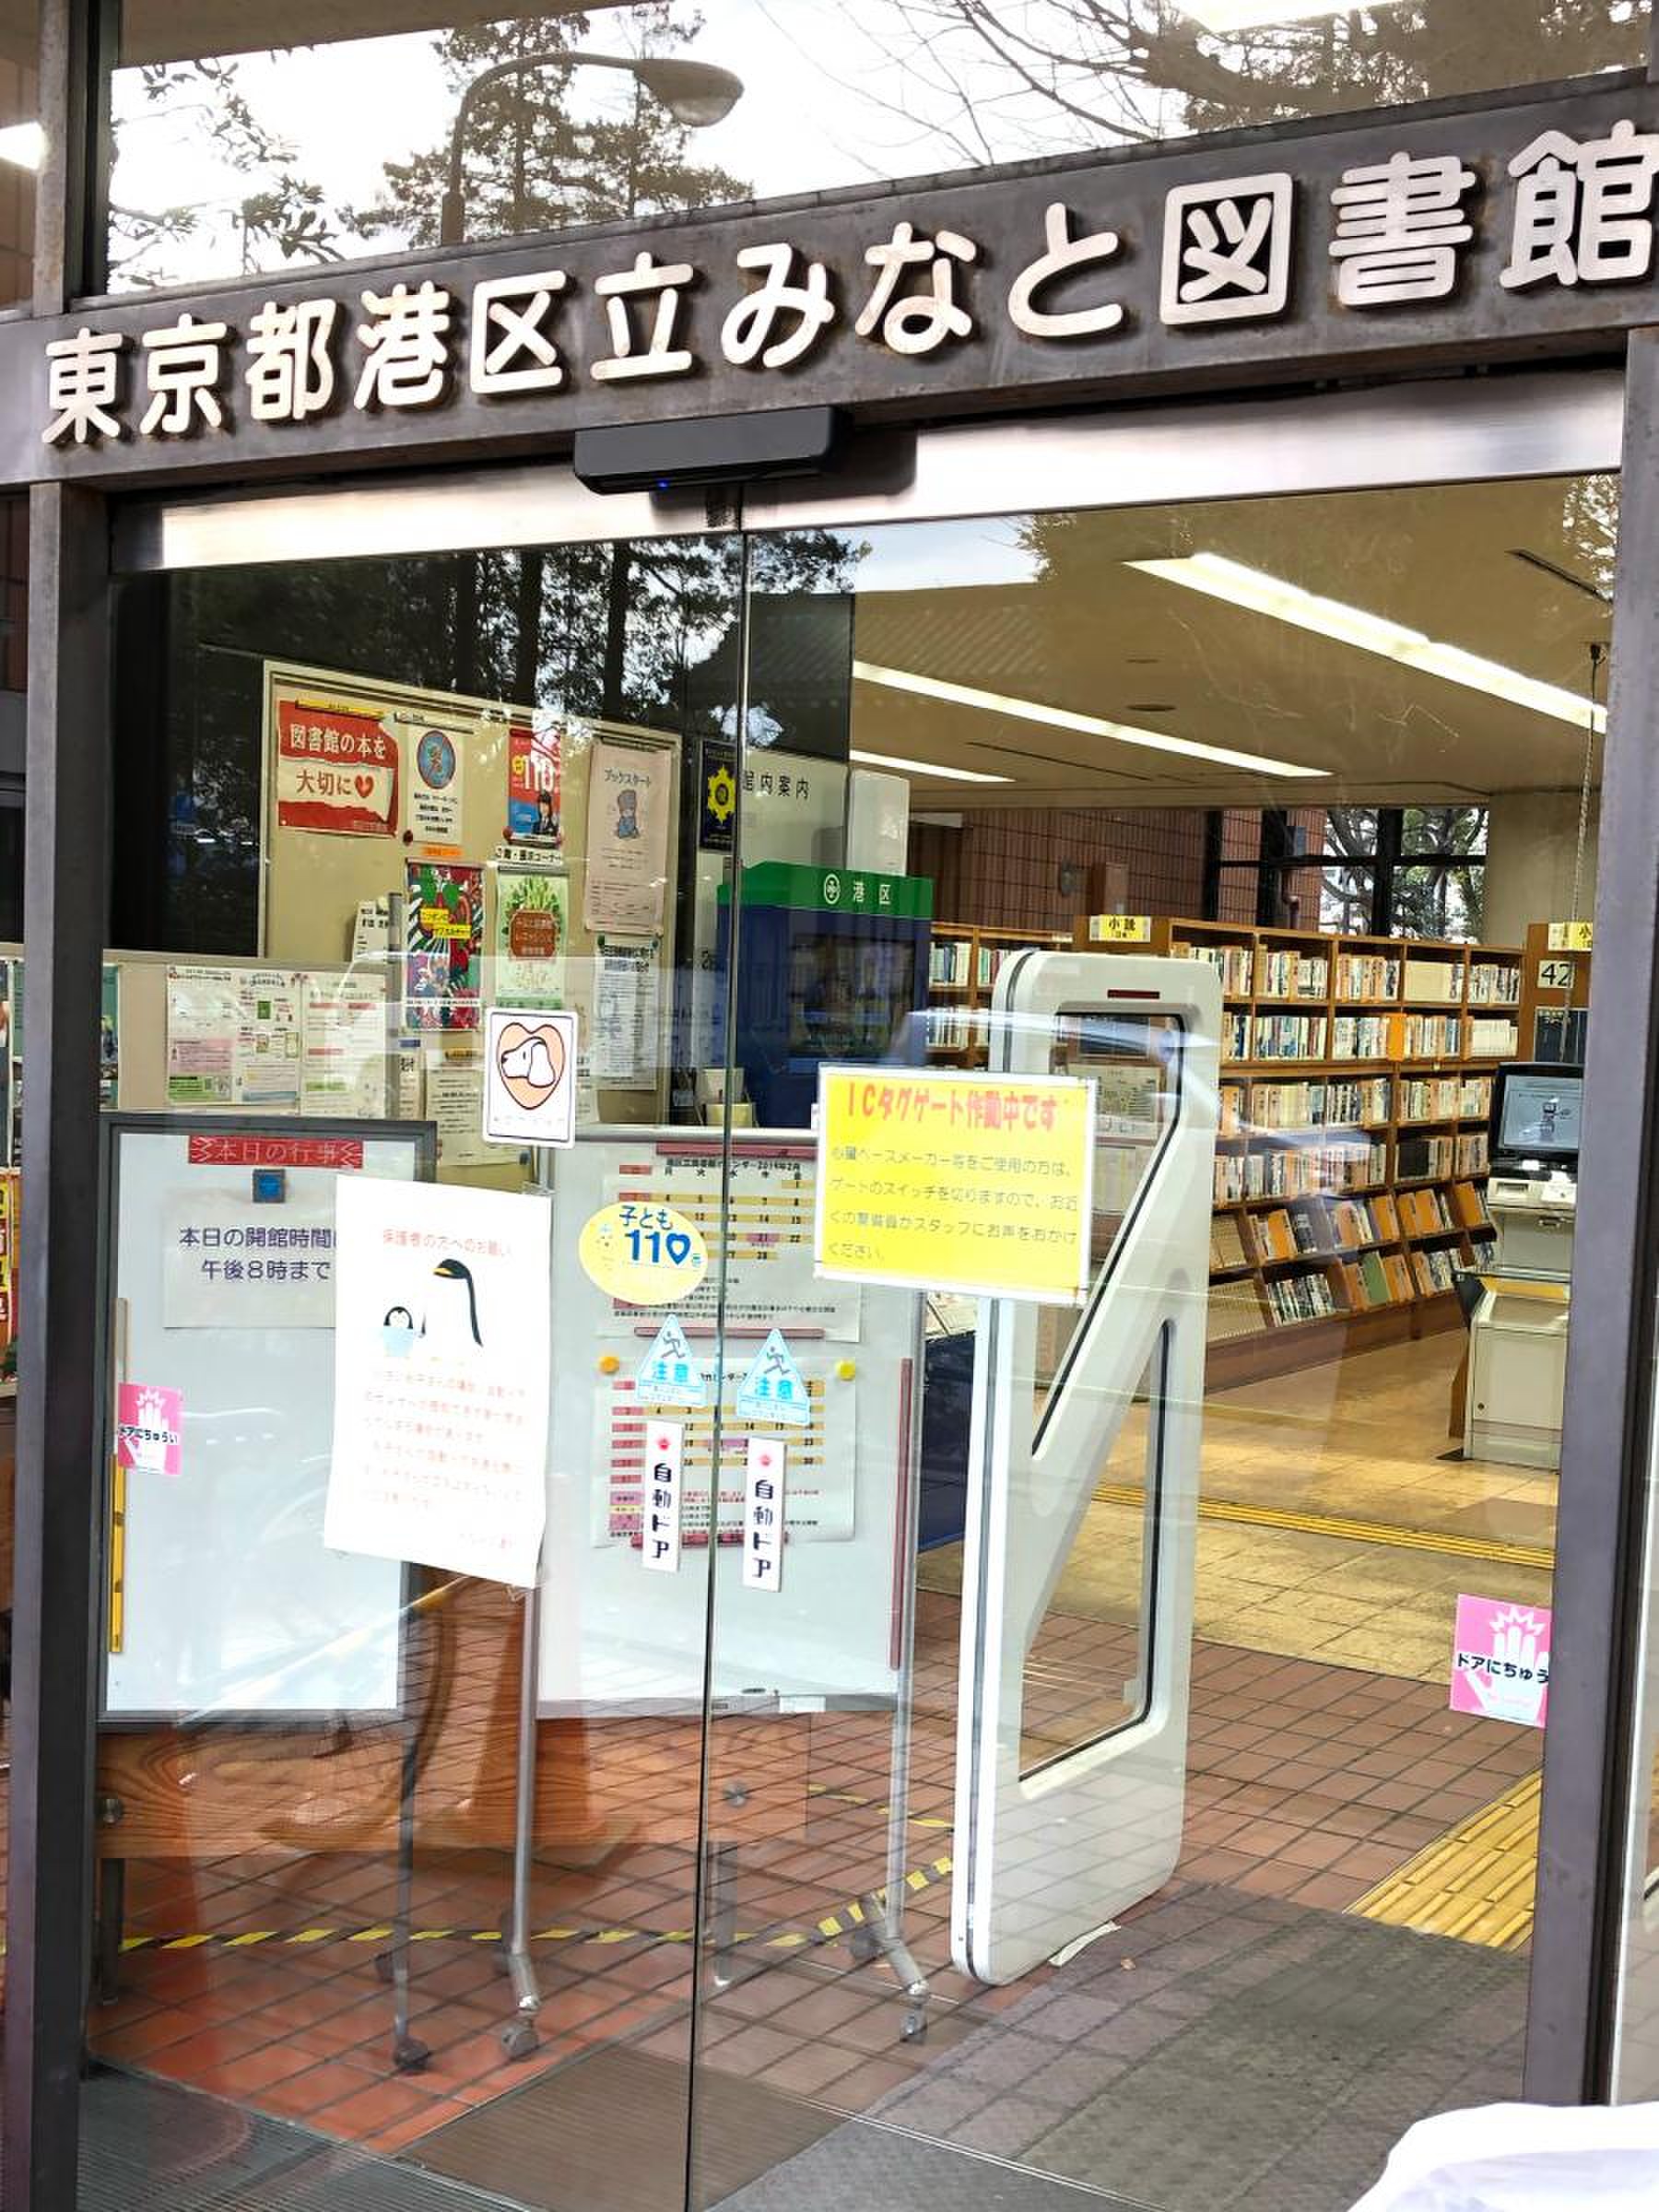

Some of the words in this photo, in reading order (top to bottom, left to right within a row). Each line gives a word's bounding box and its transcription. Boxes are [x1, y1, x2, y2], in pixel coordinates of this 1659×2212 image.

[41, 119, 1659, 445] 東京都港区立みなと図書館
[289, 723, 386, 760] 図書館の本を
[295, 769, 352, 795] 大切に
[853, 880, 891, 904] 港区
[1541, 963, 1571, 986] 42
[847, 1082, 1058, 1131] ICタグゲート作動中です
[216, 1139, 335, 1165] 本日の行事
[618, 1204, 674, 1230] 子ども
[179, 1225, 336, 1250] 本日の開館時間
[201, 1258, 331, 1281] 午後8時まで
[652, 1462, 673, 1559] 自動ドア
[752, 1479, 775, 1579] 自動ドア
